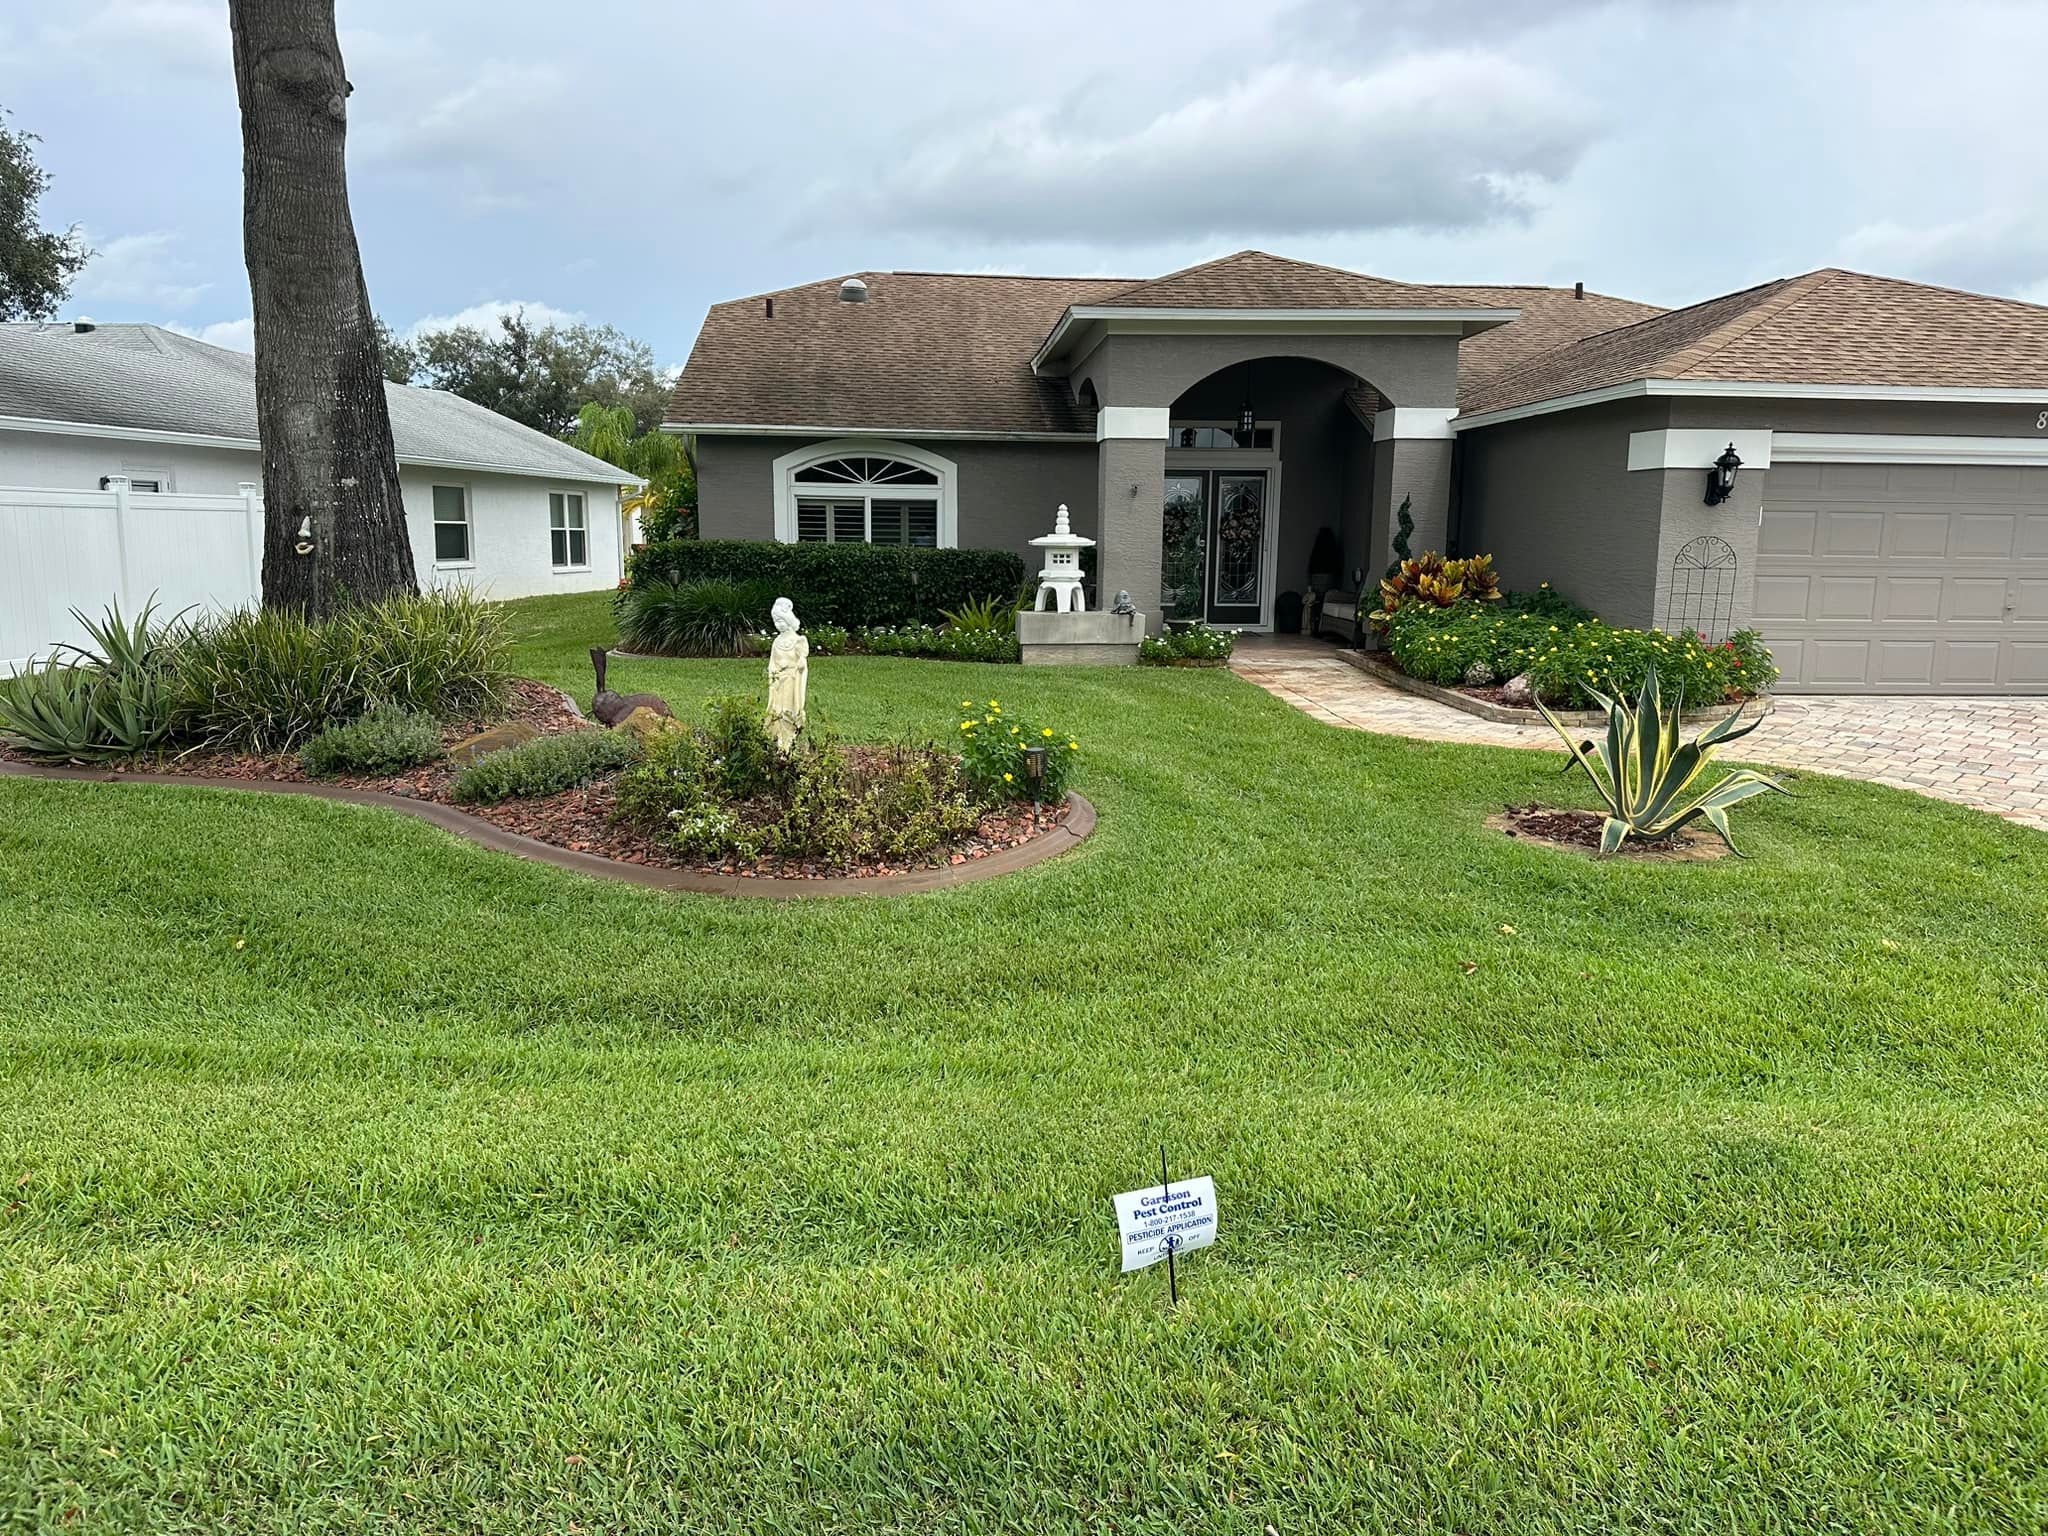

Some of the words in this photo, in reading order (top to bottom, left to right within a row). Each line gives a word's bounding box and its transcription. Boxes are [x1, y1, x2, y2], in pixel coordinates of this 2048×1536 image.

[1133, 1208, 1157, 1220] Pest
[1159, 1197, 1202, 1214] Control
[1129, 1228, 1165, 1242] PESTICIDE
[1167, 1216, 1212, 1234] APPLICATION
[1188, 1234, 1201, 1242] OFF
